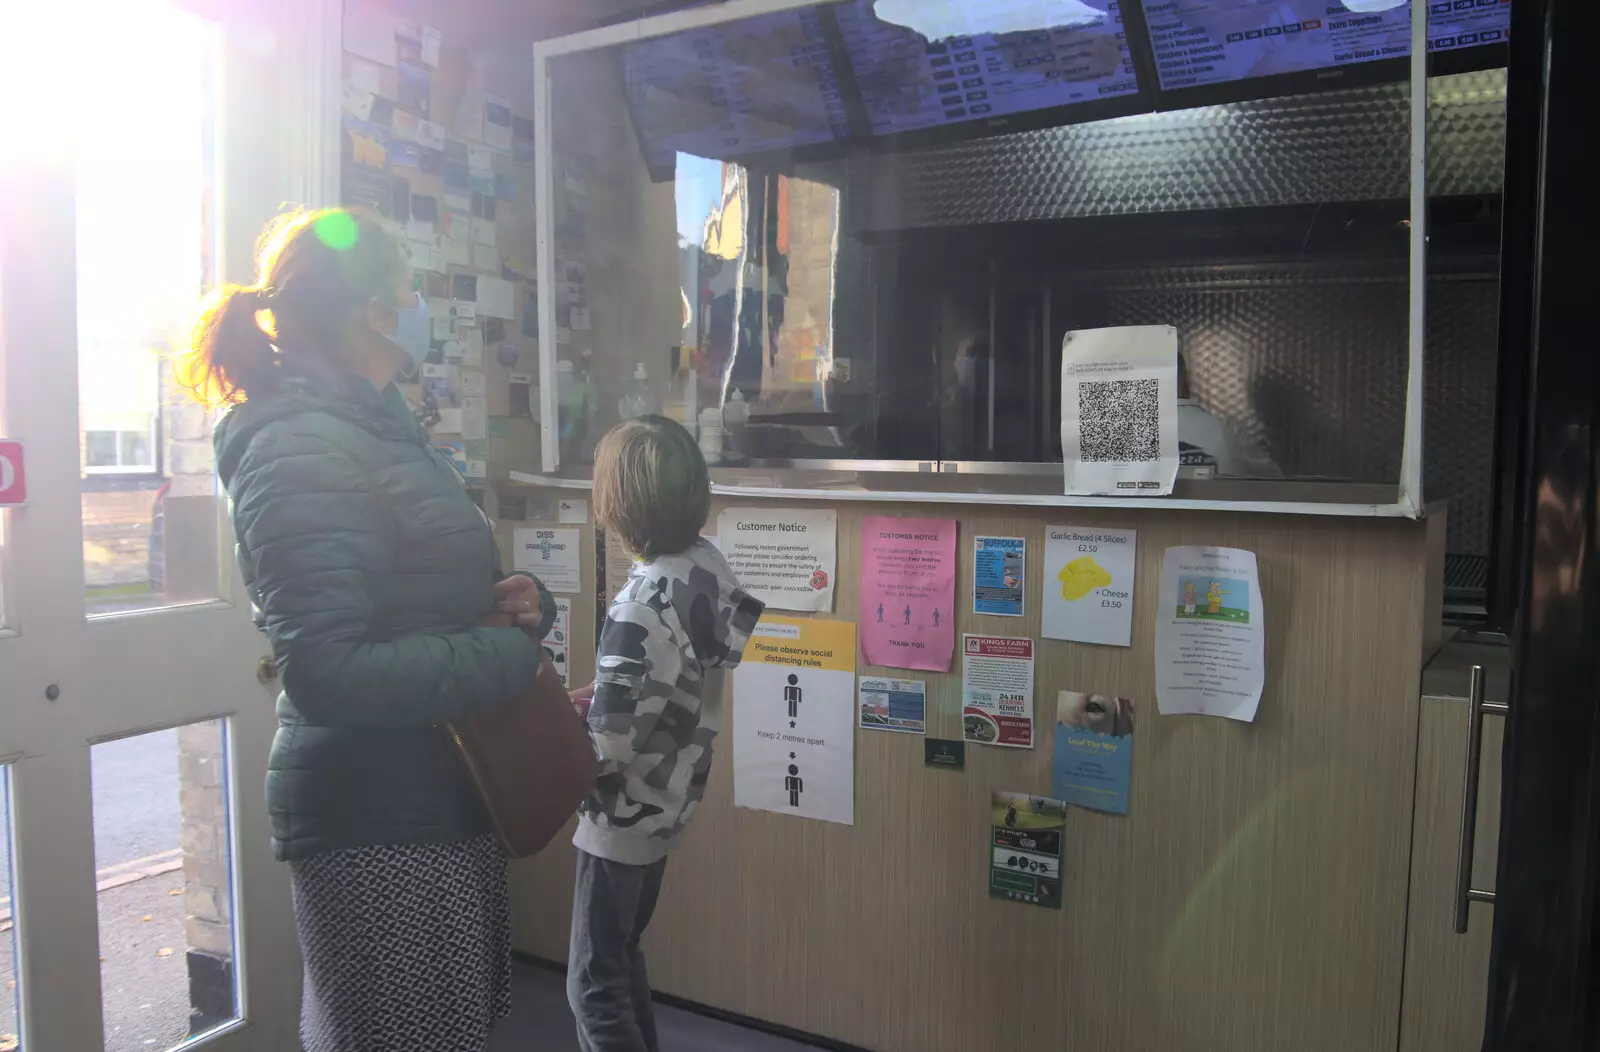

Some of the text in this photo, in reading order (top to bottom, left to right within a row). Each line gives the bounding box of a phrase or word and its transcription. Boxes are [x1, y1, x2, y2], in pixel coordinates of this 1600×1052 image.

[736, 522, 807, 532] Customer Notice
[1051, 532, 1070, 540] Garlic
[1073, 533, 1093, 542] Bread
[1104, 535, 1126, 544] Slices)
[1102, 589, 1128, 598] Cheese
[755, 643, 778, 652] Please
[780, 645, 808, 655] observe
[910, 641, 924, 649] YOU
[764, 655, 801, 666] distancing
[757, 730, 775, 740] Keep
